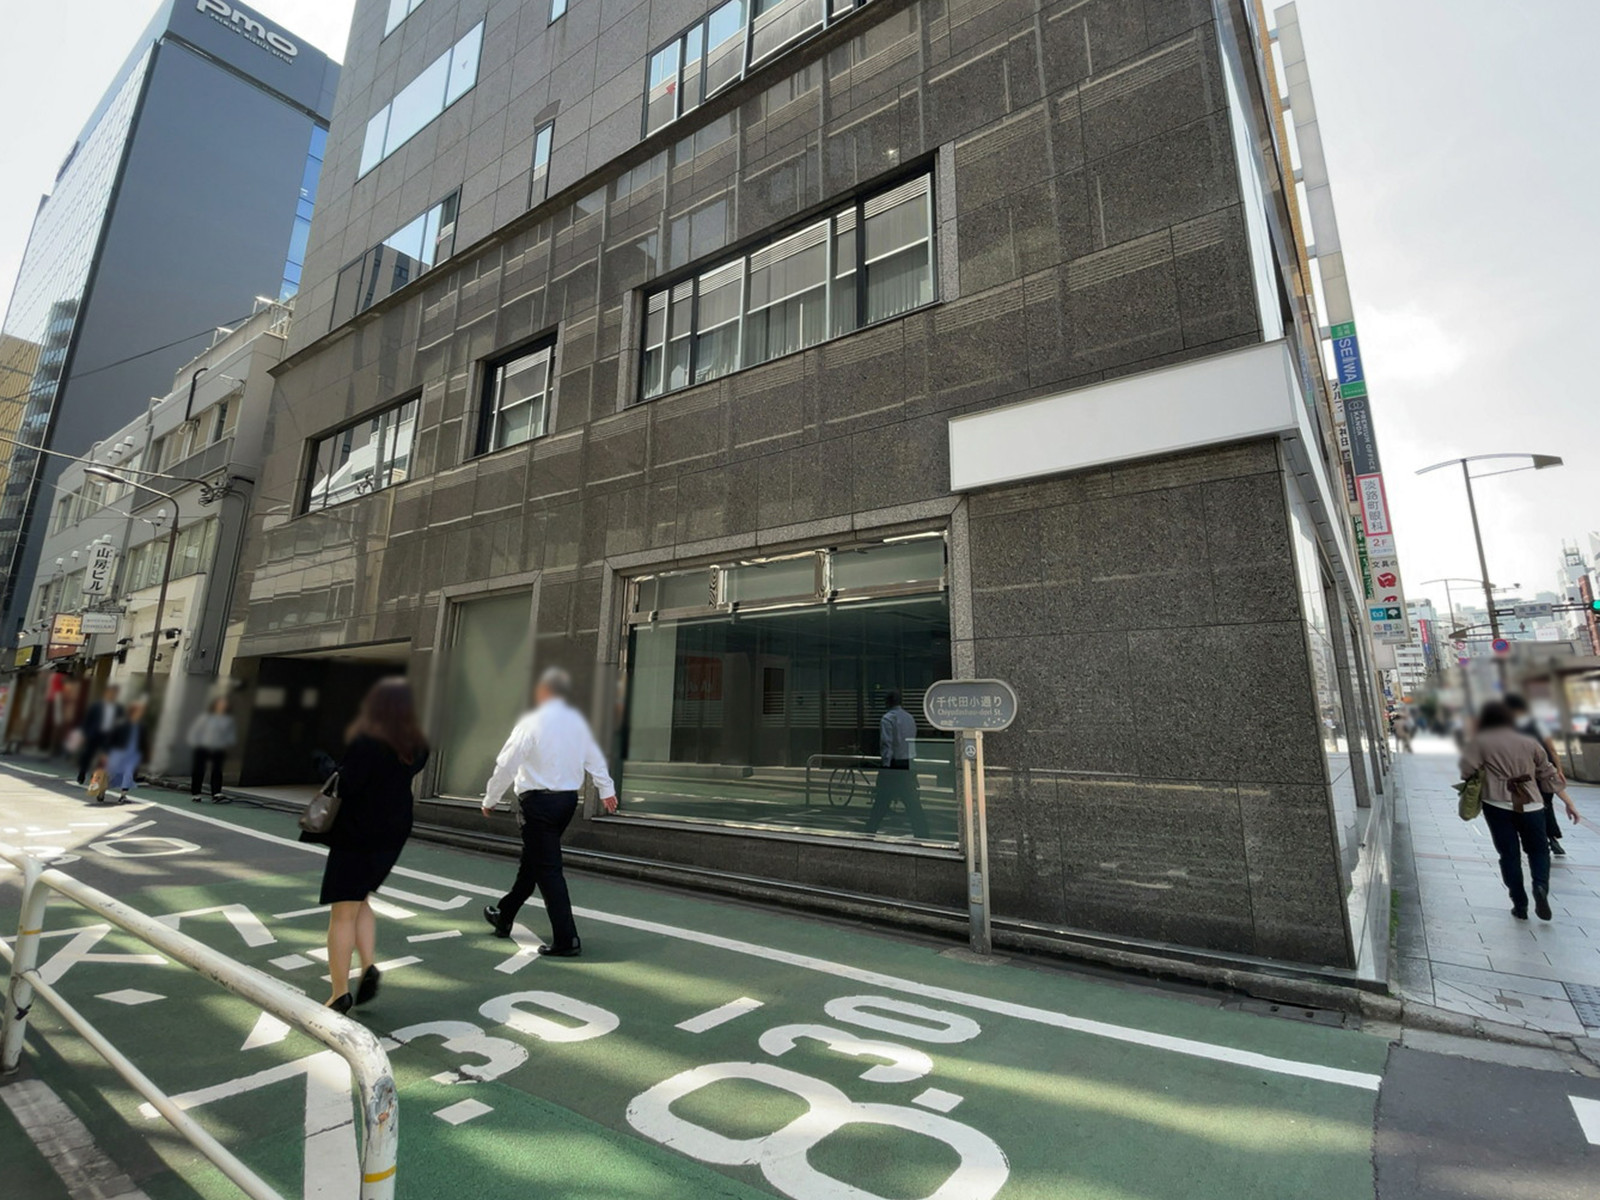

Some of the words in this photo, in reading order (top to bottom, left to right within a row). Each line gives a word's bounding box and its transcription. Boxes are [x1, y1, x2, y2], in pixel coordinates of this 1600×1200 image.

[196, 0, 298, 56] pmo
[1364, 480, 1384, 531] 淡路町眼科
[90, 547, 110, 591] 山房ビル
[936, 695, 1002, 708] 千代田小通り
